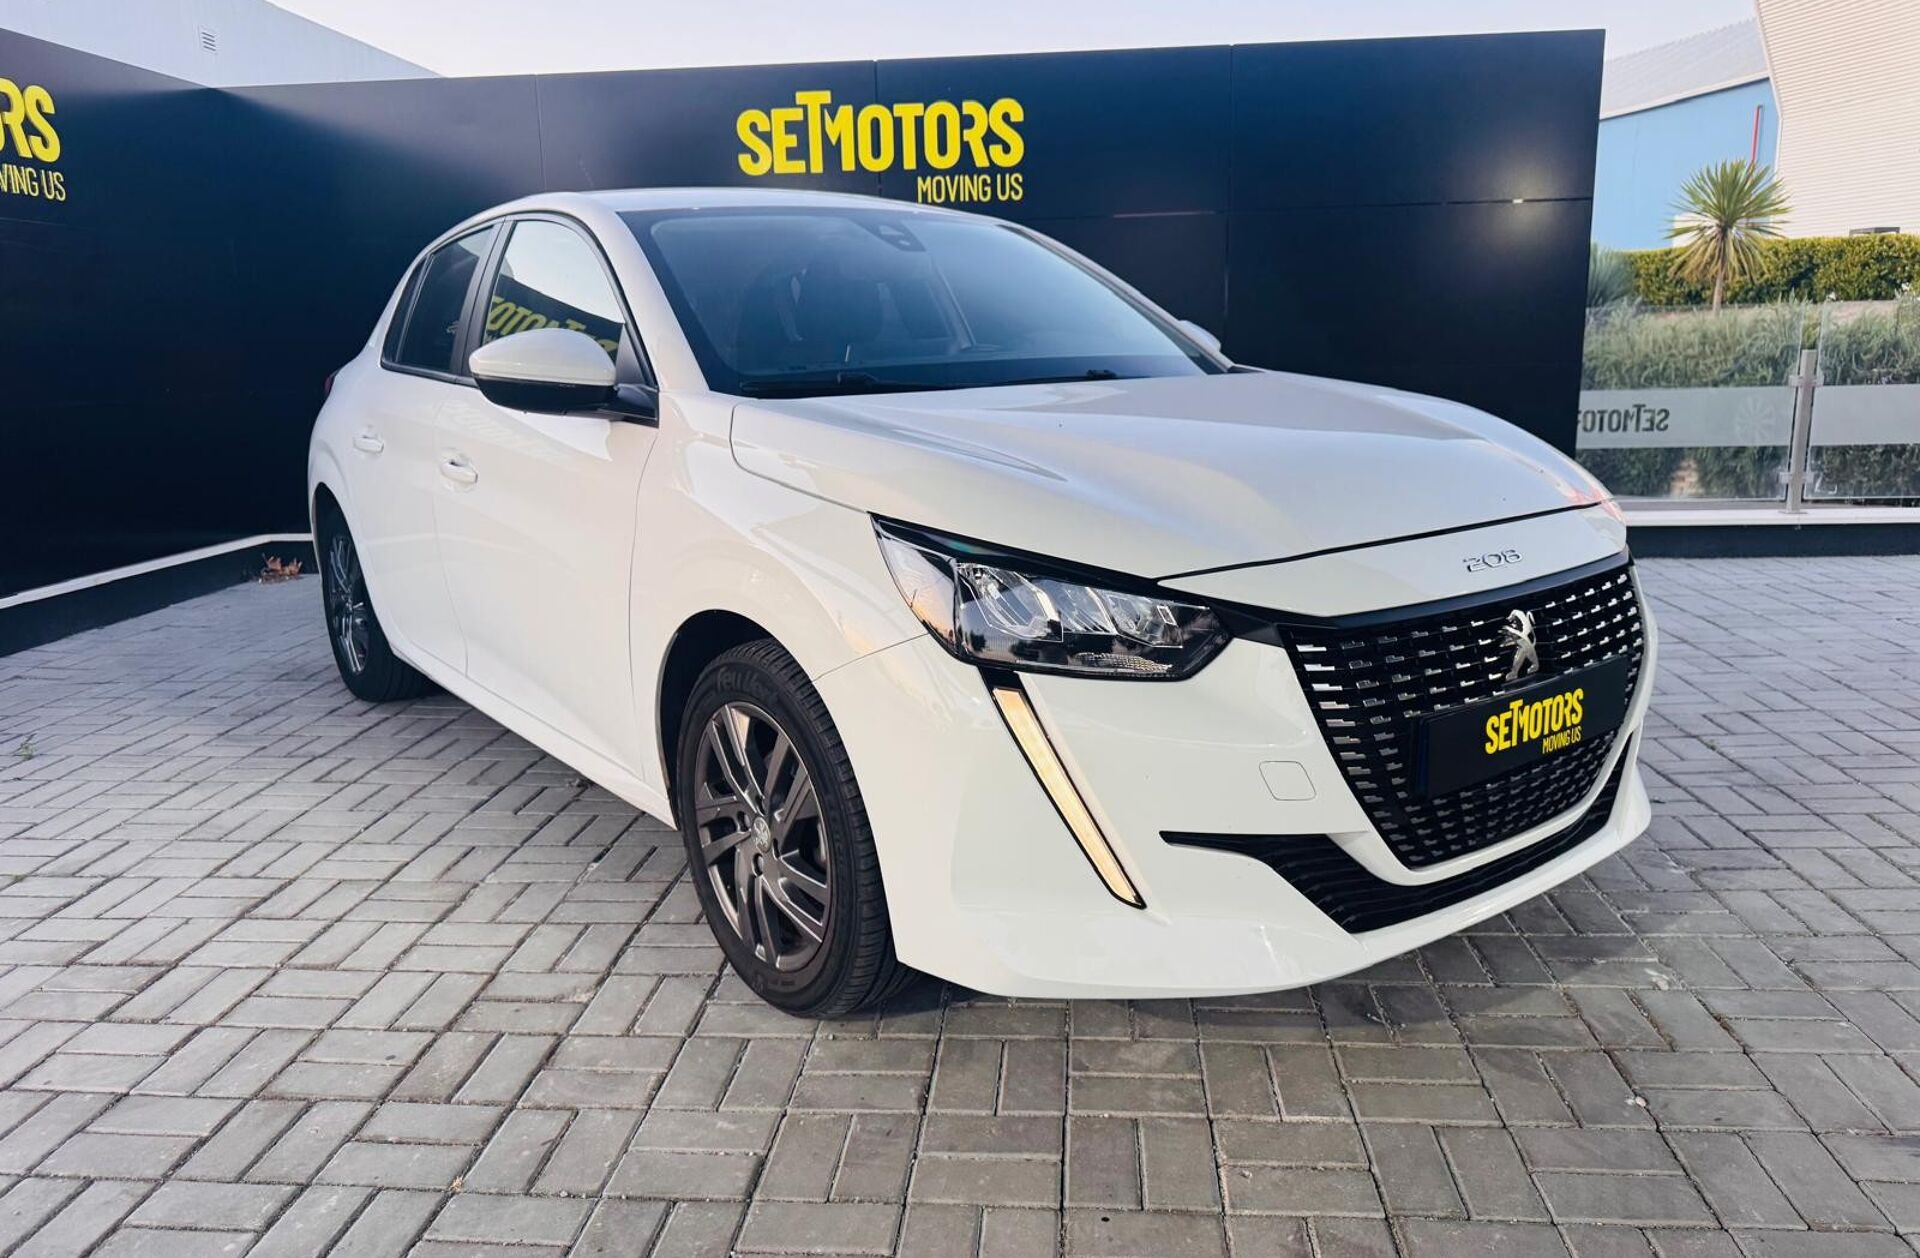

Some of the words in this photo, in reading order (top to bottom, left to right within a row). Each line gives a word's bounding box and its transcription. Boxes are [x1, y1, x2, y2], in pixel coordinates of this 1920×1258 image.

[0, 78, 61, 162] RS
[736, 90, 1025, 176] SETMOTORS
[41, 169, 67, 201] US
[917, 174, 992, 204] MOVING
[996, 173, 1024, 201] US
[1485, 688, 1584, 754] SETMOTORS
[1542, 730, 1571, 754] MOVING
[1571, 726, 1582, 744] US
